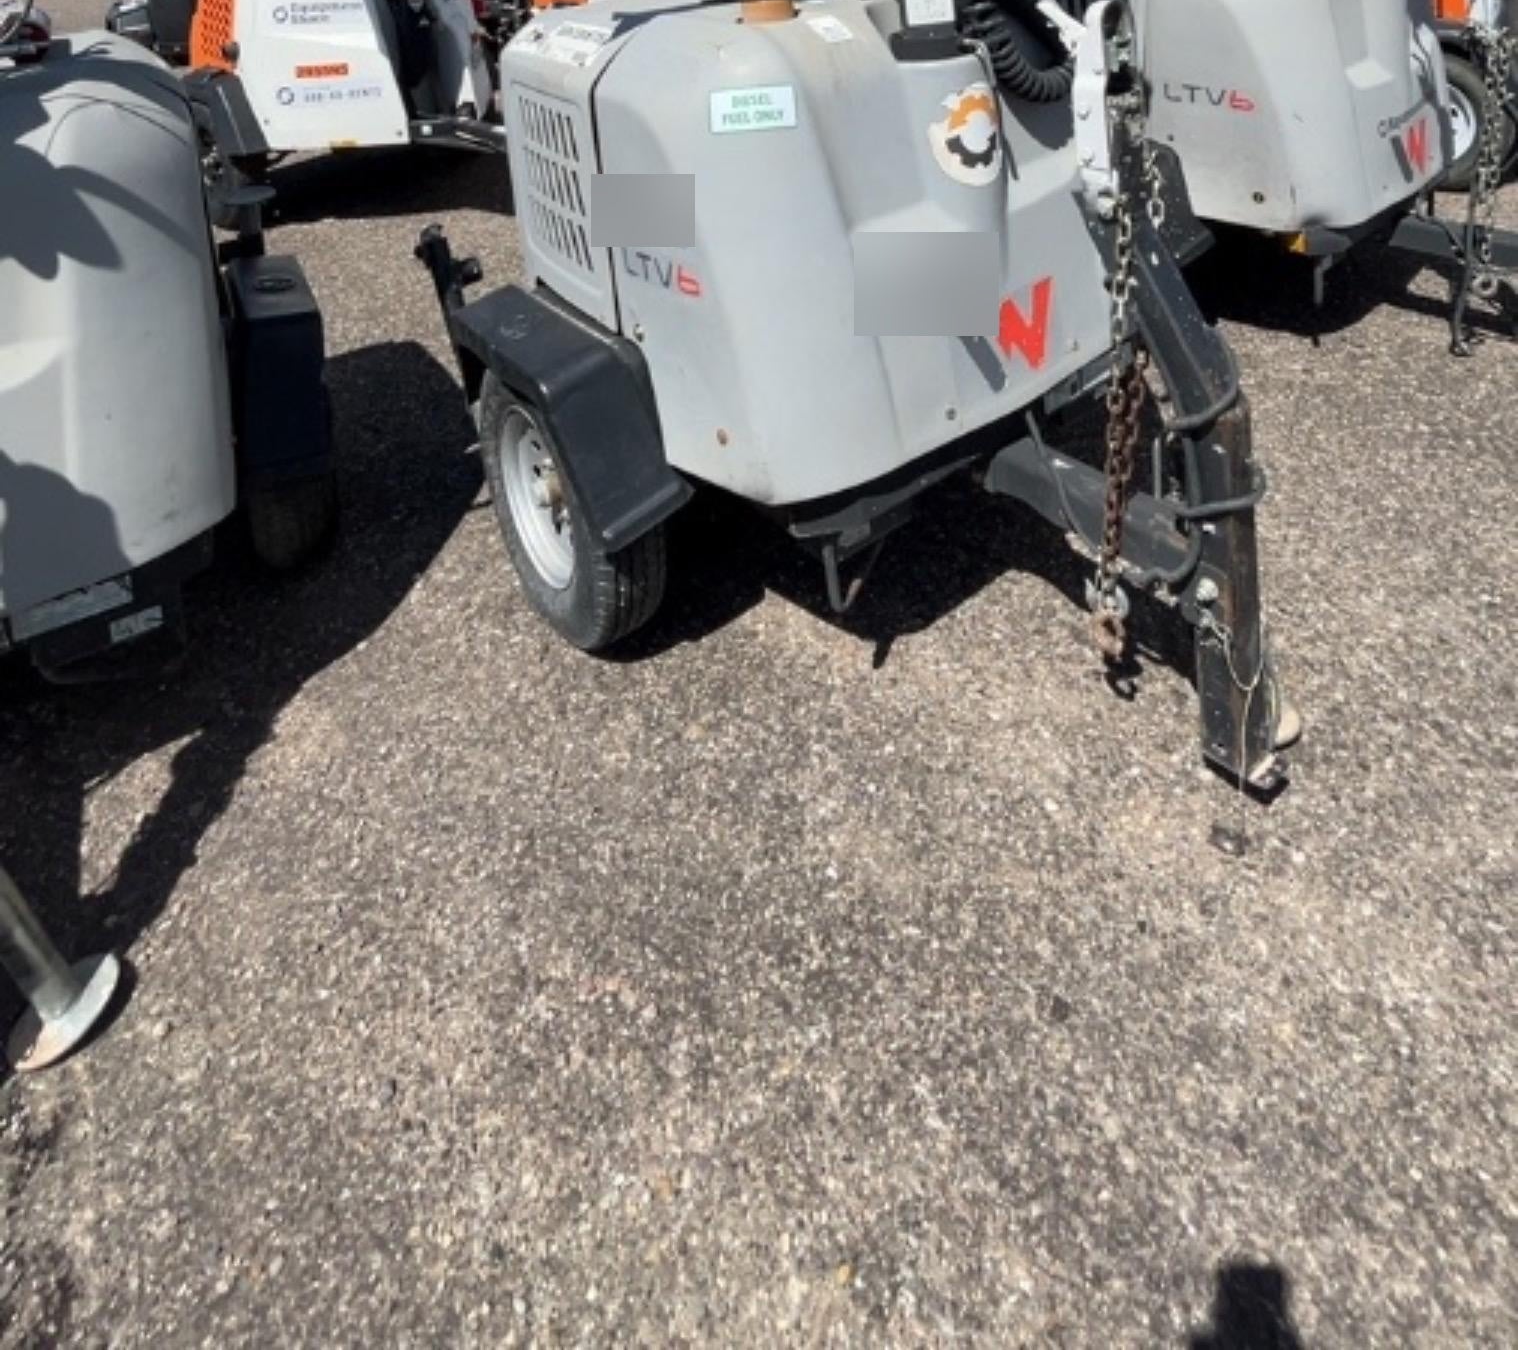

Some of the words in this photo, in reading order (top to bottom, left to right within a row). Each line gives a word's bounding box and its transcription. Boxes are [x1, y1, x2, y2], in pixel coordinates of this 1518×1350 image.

[731, 92, 774, 109] DIESEL
[722, 111, 751, 127] FUEL
[753, 108, 784, 123] ONLY
